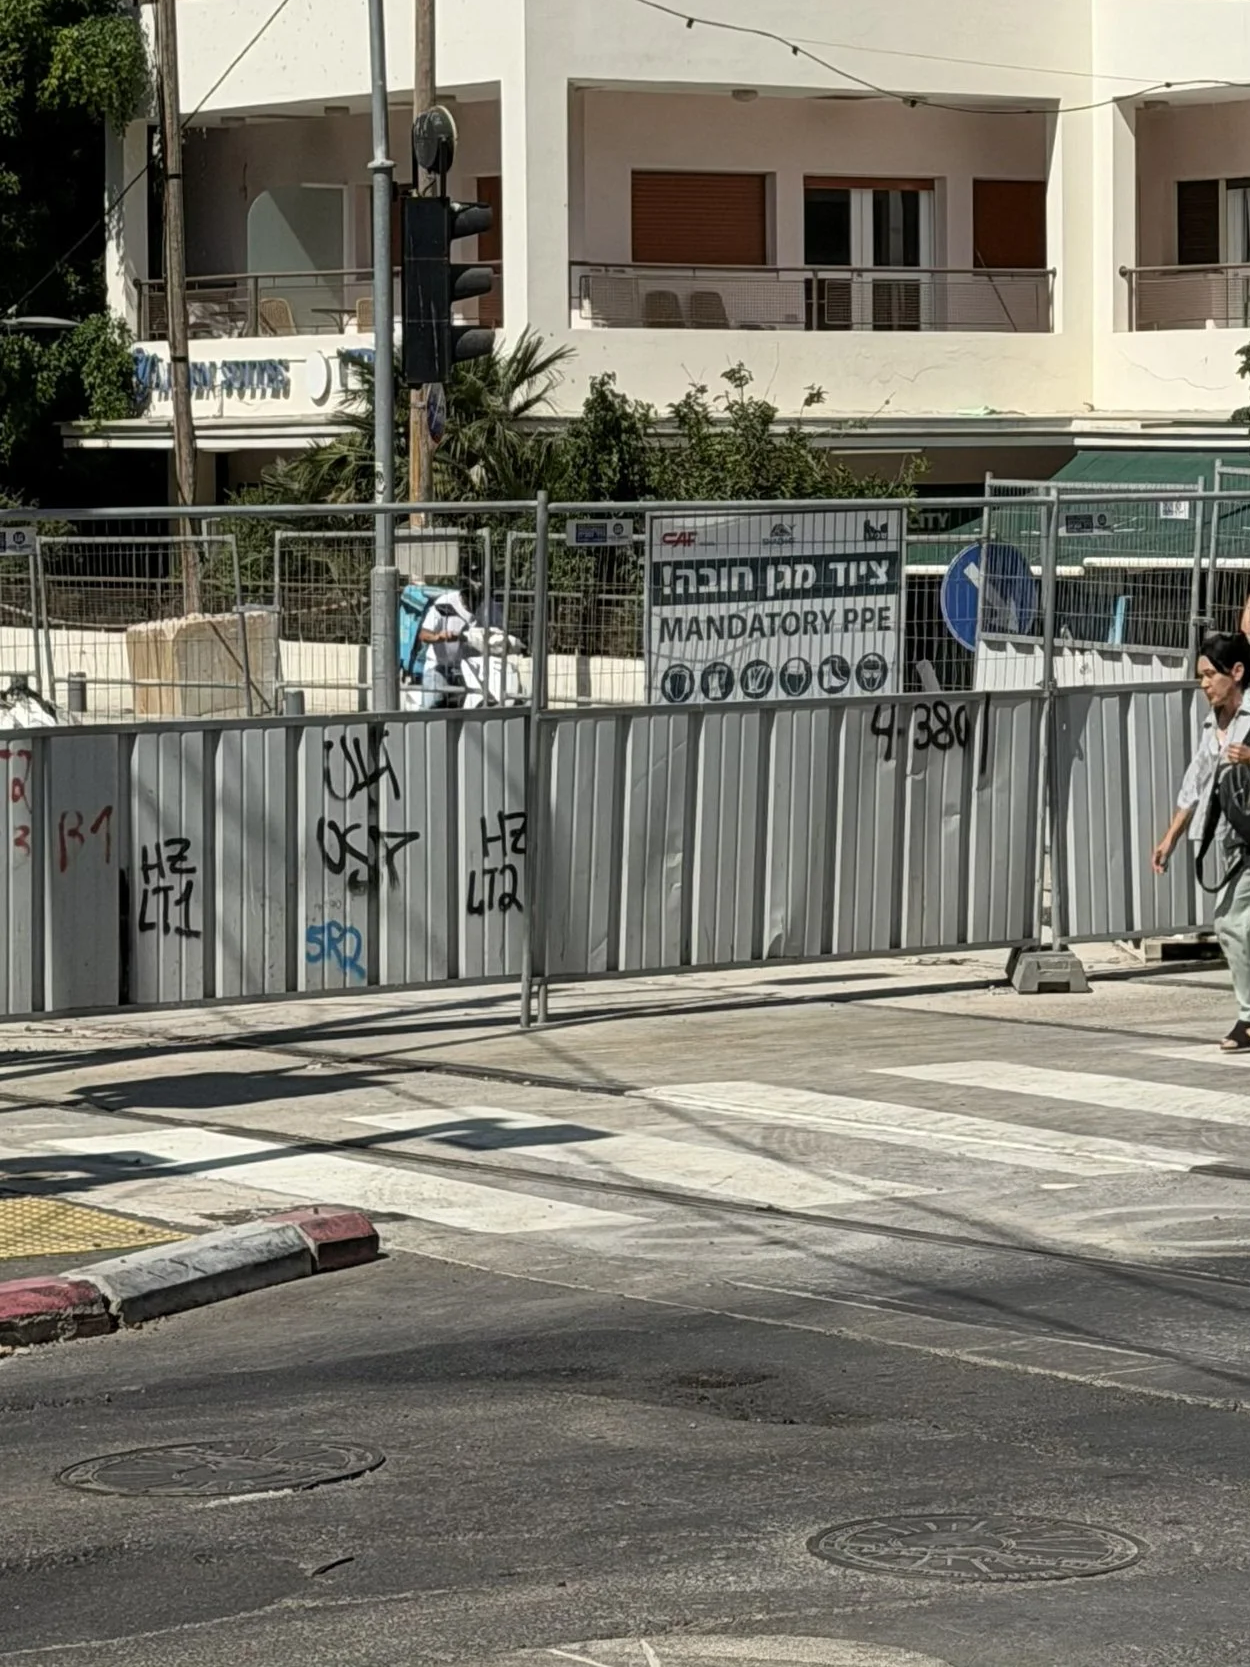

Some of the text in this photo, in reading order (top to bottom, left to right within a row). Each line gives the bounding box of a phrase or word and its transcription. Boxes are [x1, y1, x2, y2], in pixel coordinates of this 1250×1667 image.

[662, 559, 890, 598] ציוד מגן חובה!
[659, 605, 892, 644] MANDATORY PPE
